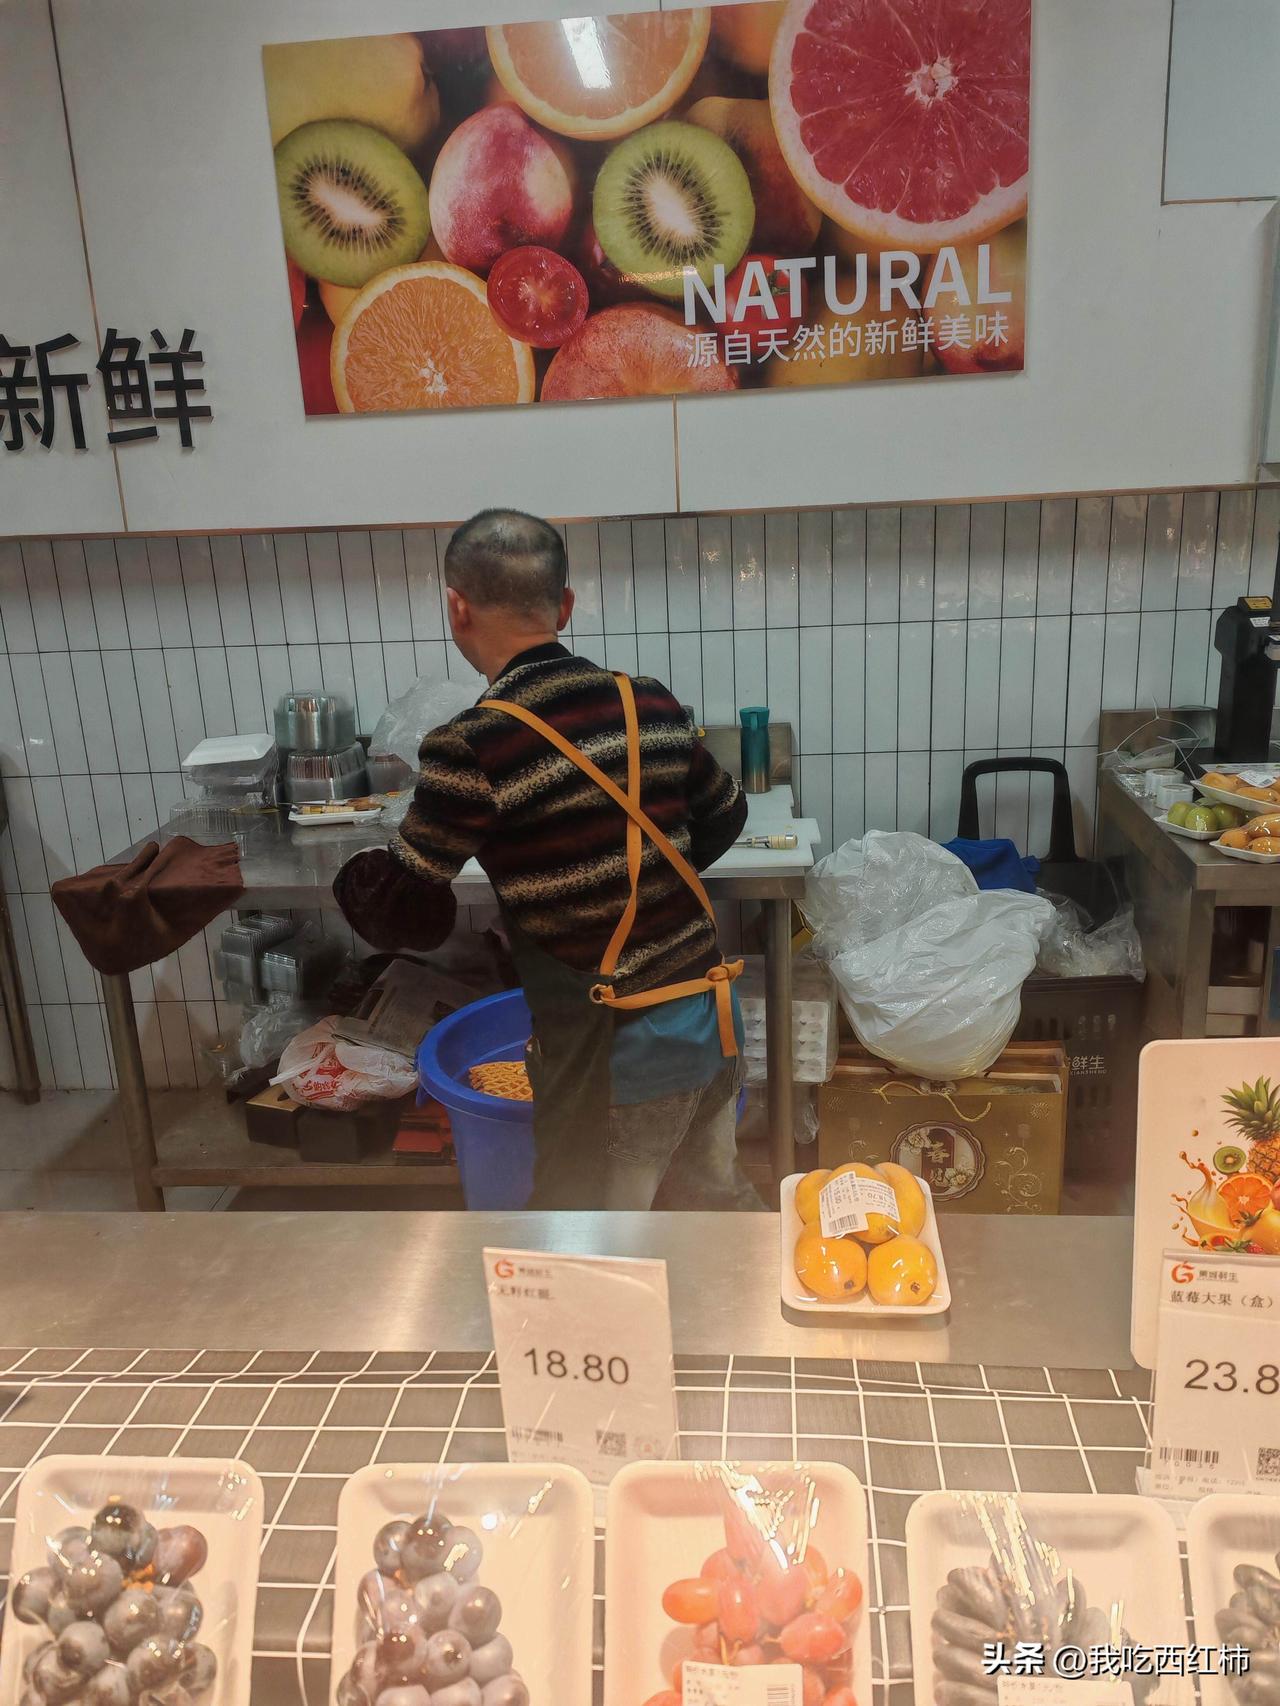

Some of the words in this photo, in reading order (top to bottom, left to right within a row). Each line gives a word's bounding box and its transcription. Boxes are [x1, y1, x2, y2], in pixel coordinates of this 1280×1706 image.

[682, 243, 1013, 326] NATURAL
[685, 310, 1010, 369] 源自天然的新鲜美味
[0, 327, 213, 451] 新鲜
[1066, 1054, 1105, 1070] 鲜生
[524, 1347, 629, 1385] 18.80
[1184, 1358, 1280, 1395] 23.8
